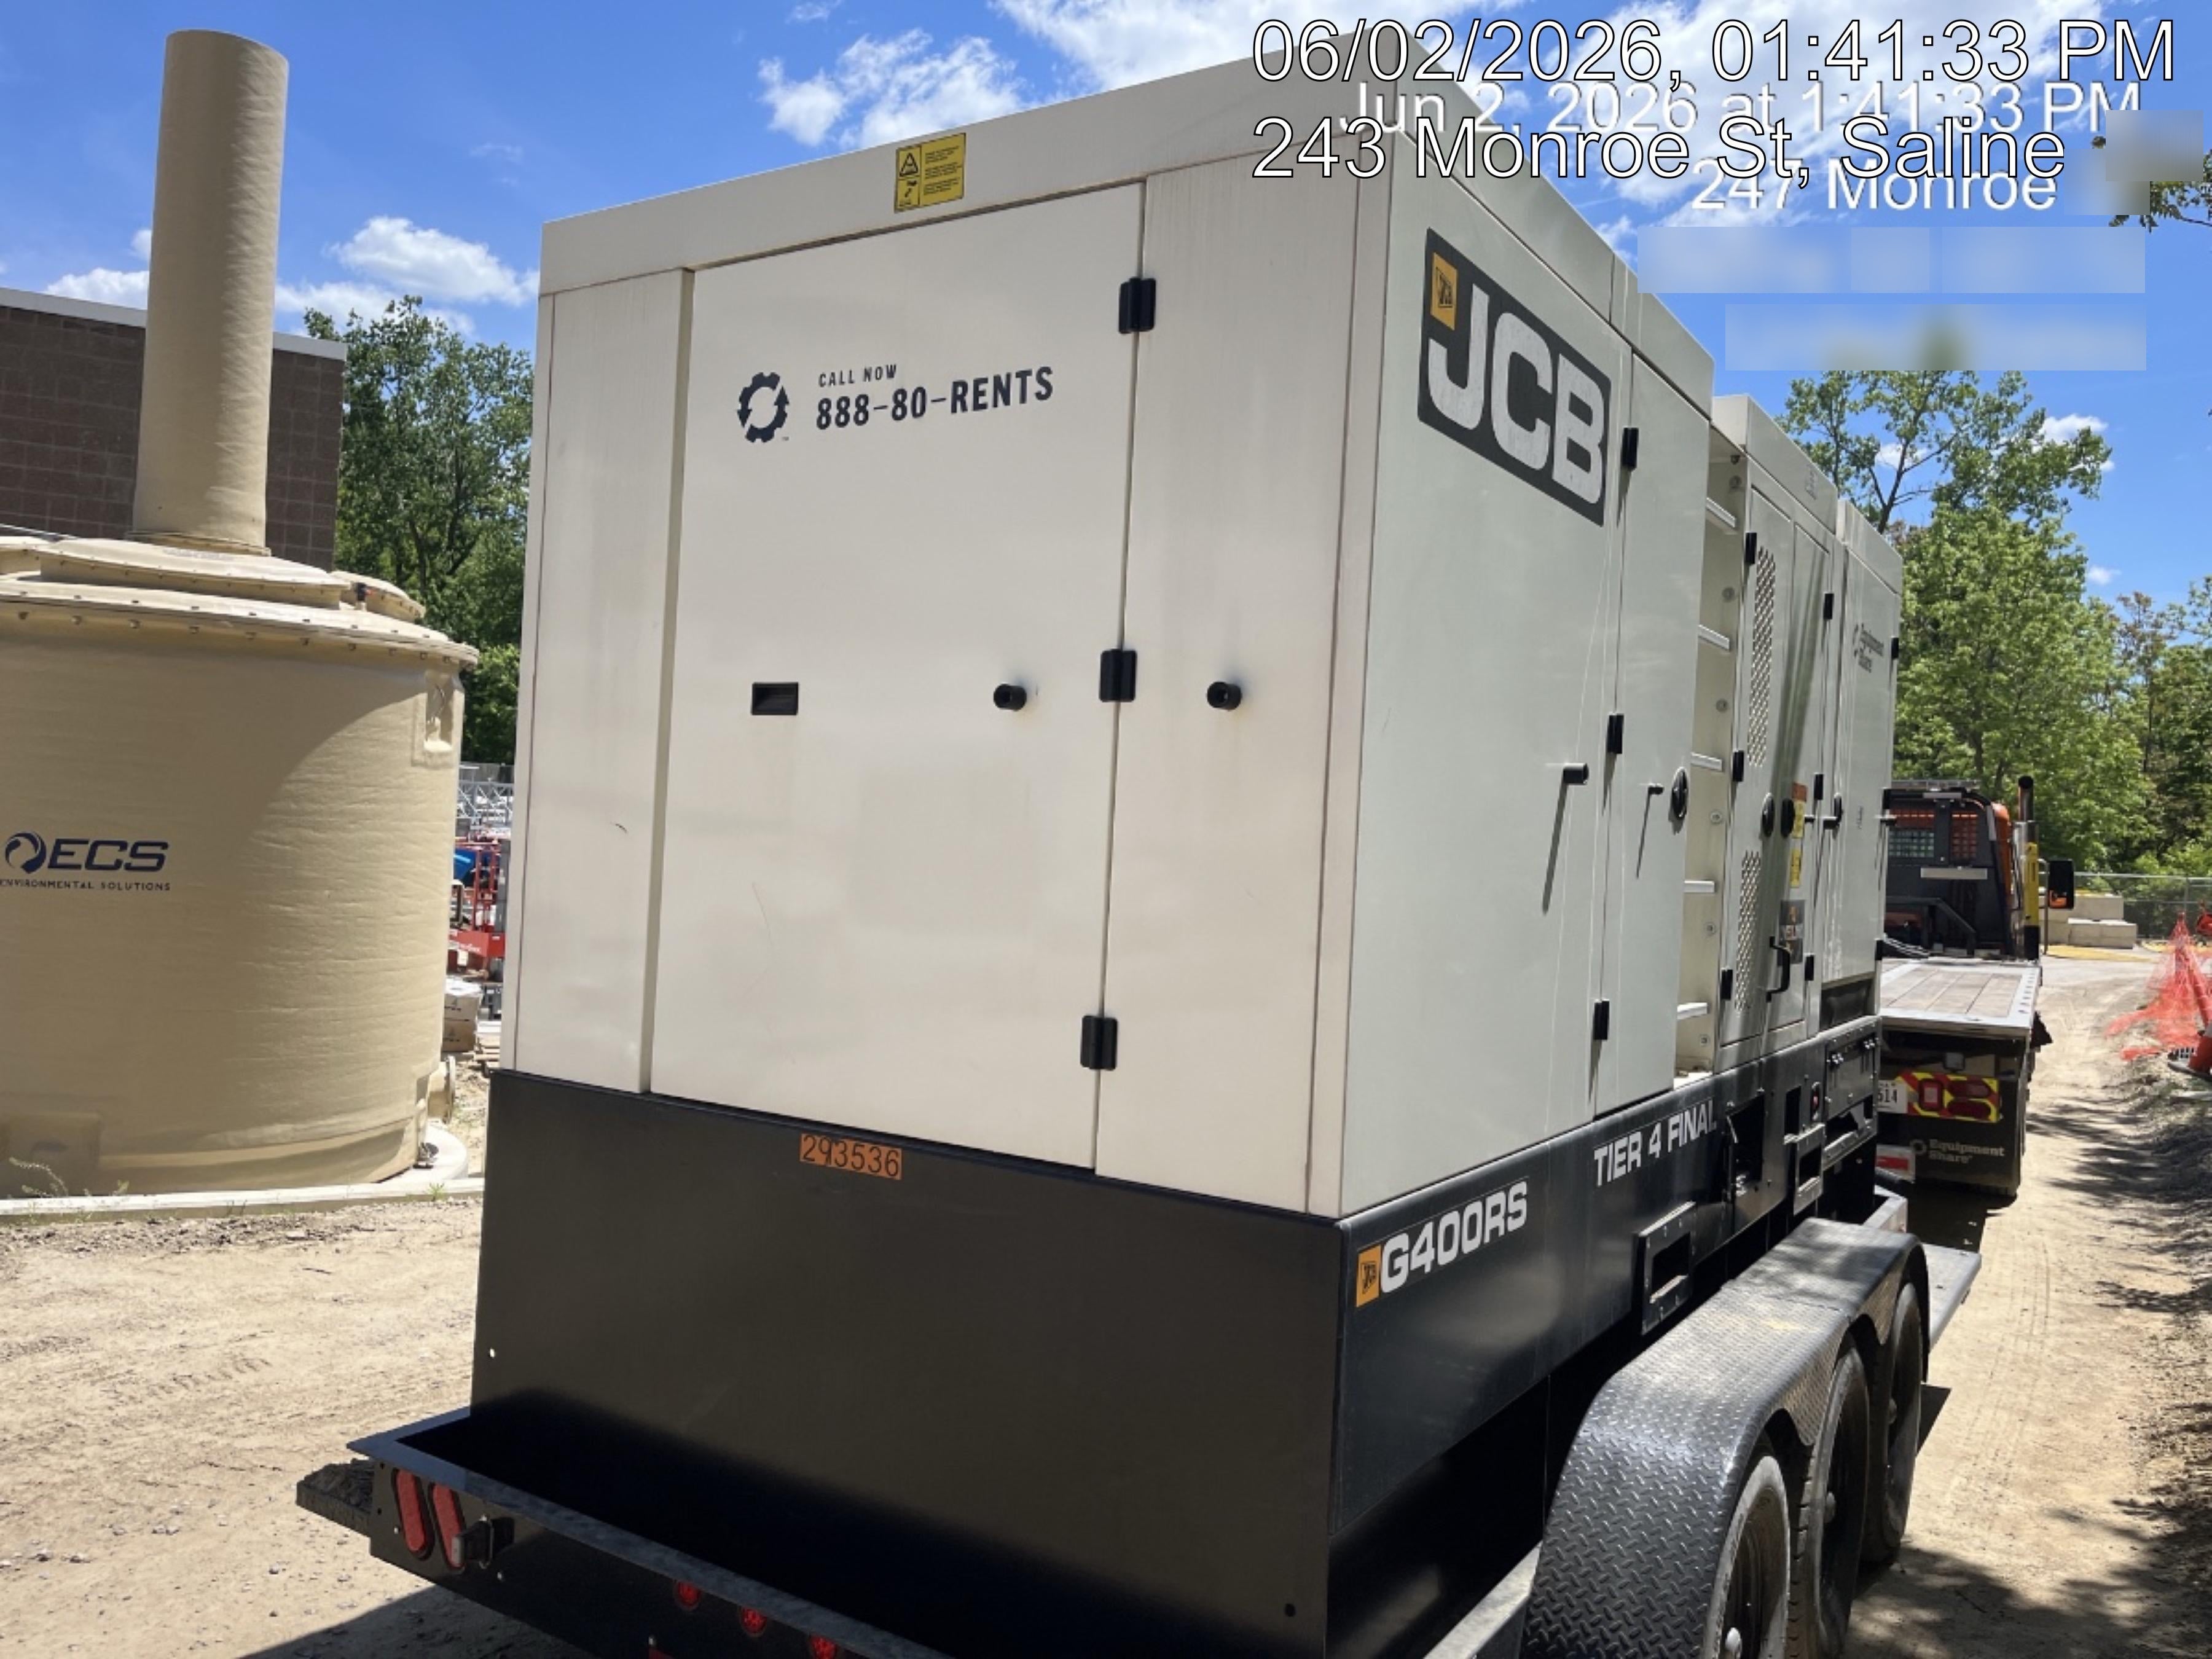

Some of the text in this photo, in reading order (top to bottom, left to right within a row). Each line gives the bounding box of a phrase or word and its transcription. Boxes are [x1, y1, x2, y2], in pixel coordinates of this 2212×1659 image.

[816, 366, 1053, 430] 888-80-RENTS
[818, 364, 897, 388] CALL NOW
[1428, 284, 1605, 504] JCB
[47, 838, 170, 872] ECS
[0, 879, 171, 891] ENVIRONMENTAL SOLUTIONS
[802, 1134, 900, 1177] 293536
[1594, 1100, 1717, 1188] TIER 4 FINAL
[1381, 1181, 1528, 1293] G400RS
